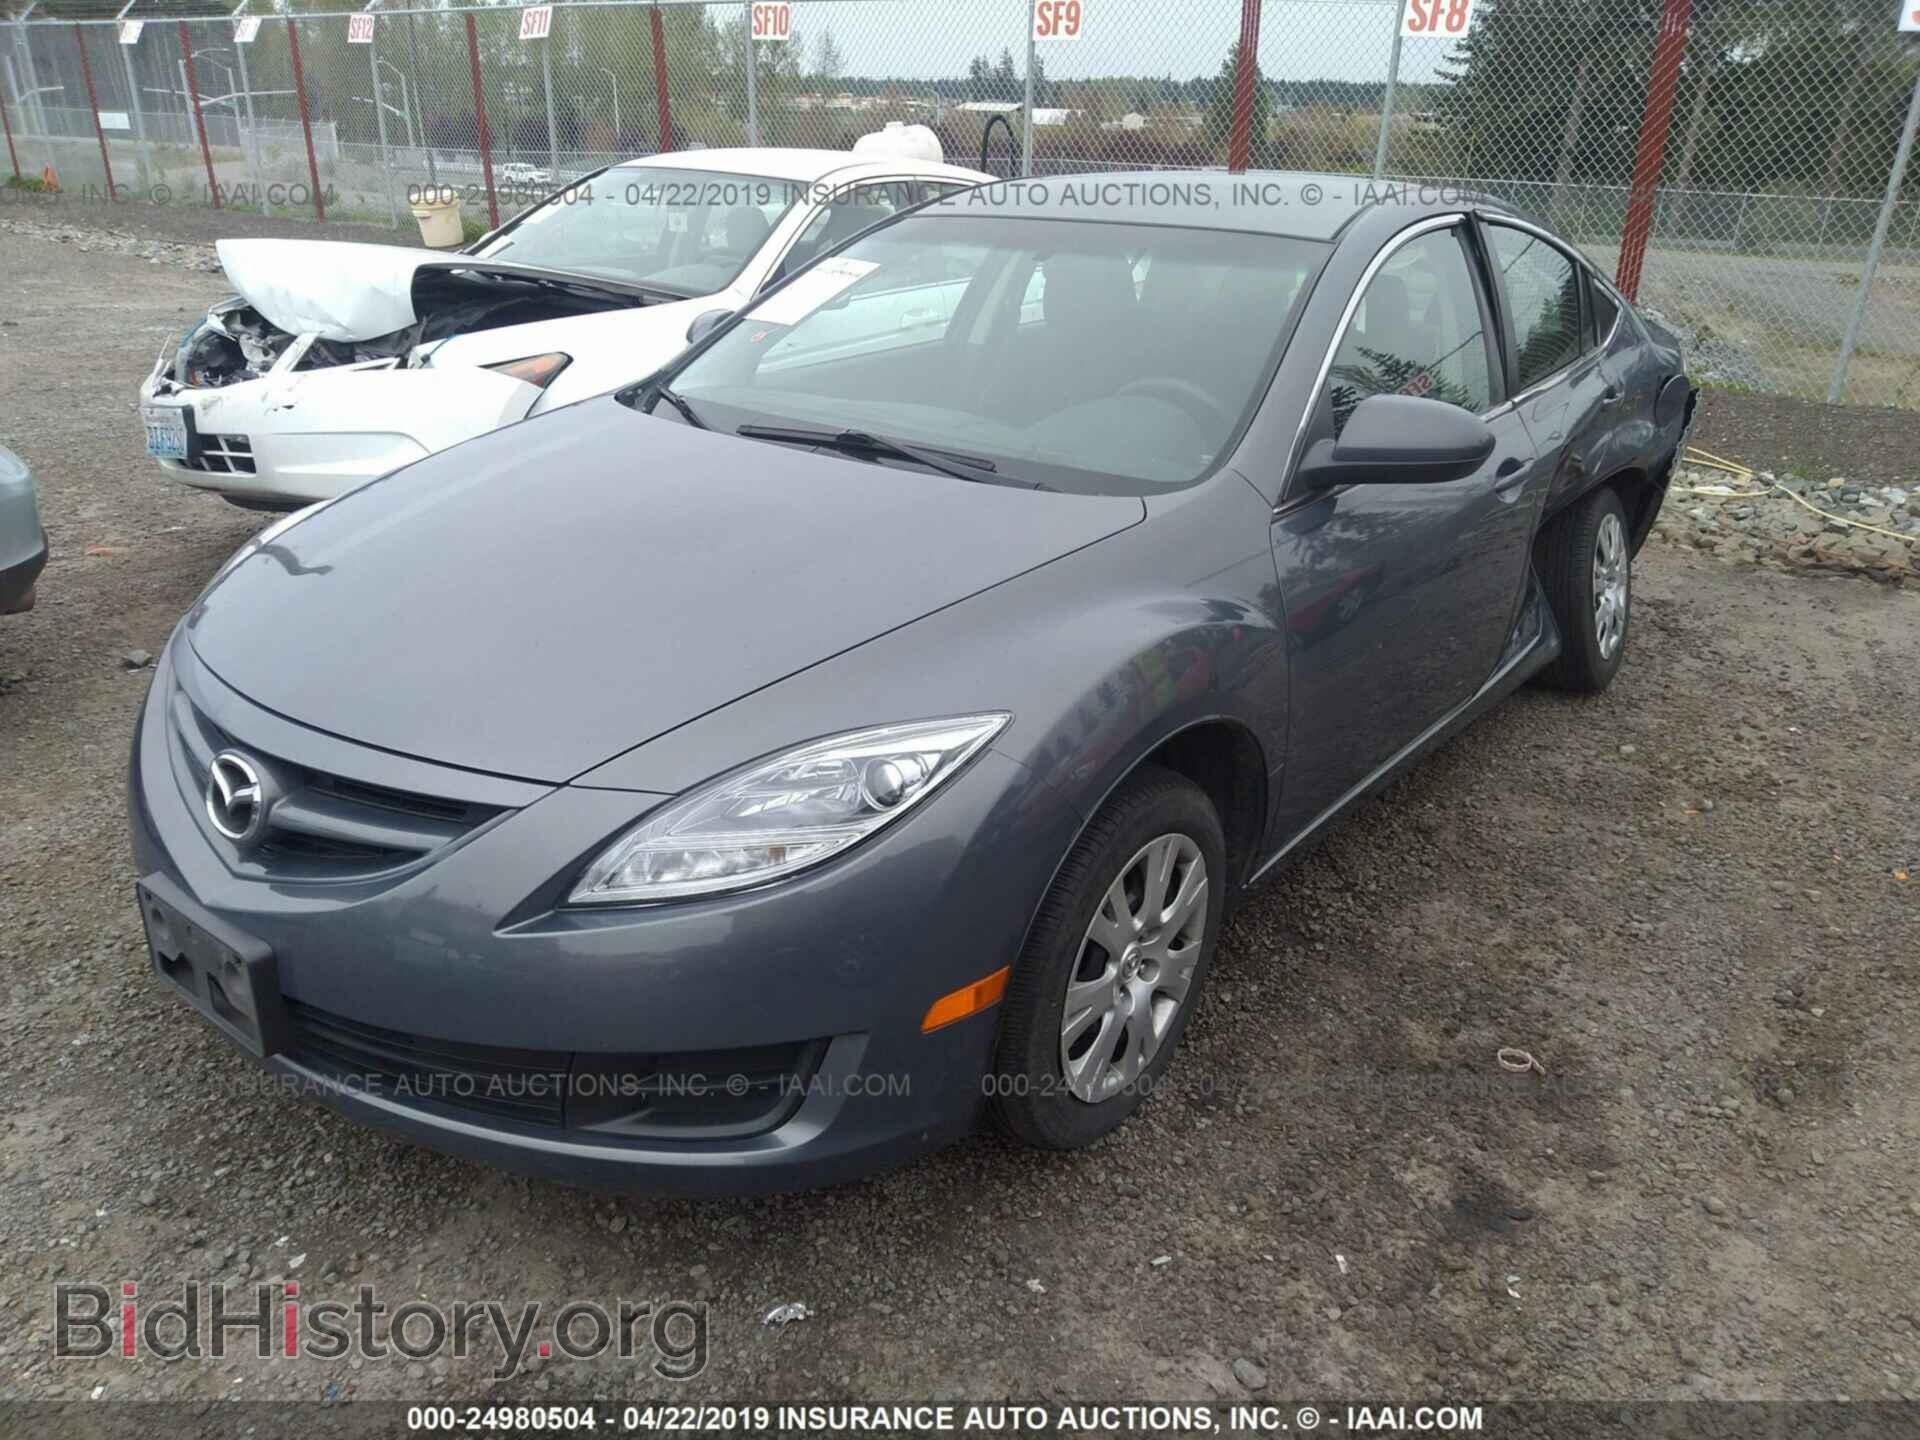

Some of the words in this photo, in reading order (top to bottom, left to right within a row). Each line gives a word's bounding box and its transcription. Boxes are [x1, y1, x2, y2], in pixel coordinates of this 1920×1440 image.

[349, 15, 374, 40] SF12
[521, 8, 550, 36] SF11
[753, 4, 790, 36] SF10
[1036, 0, 1082, 37] SF9
[1407, 0, 1469, 32] SF8
